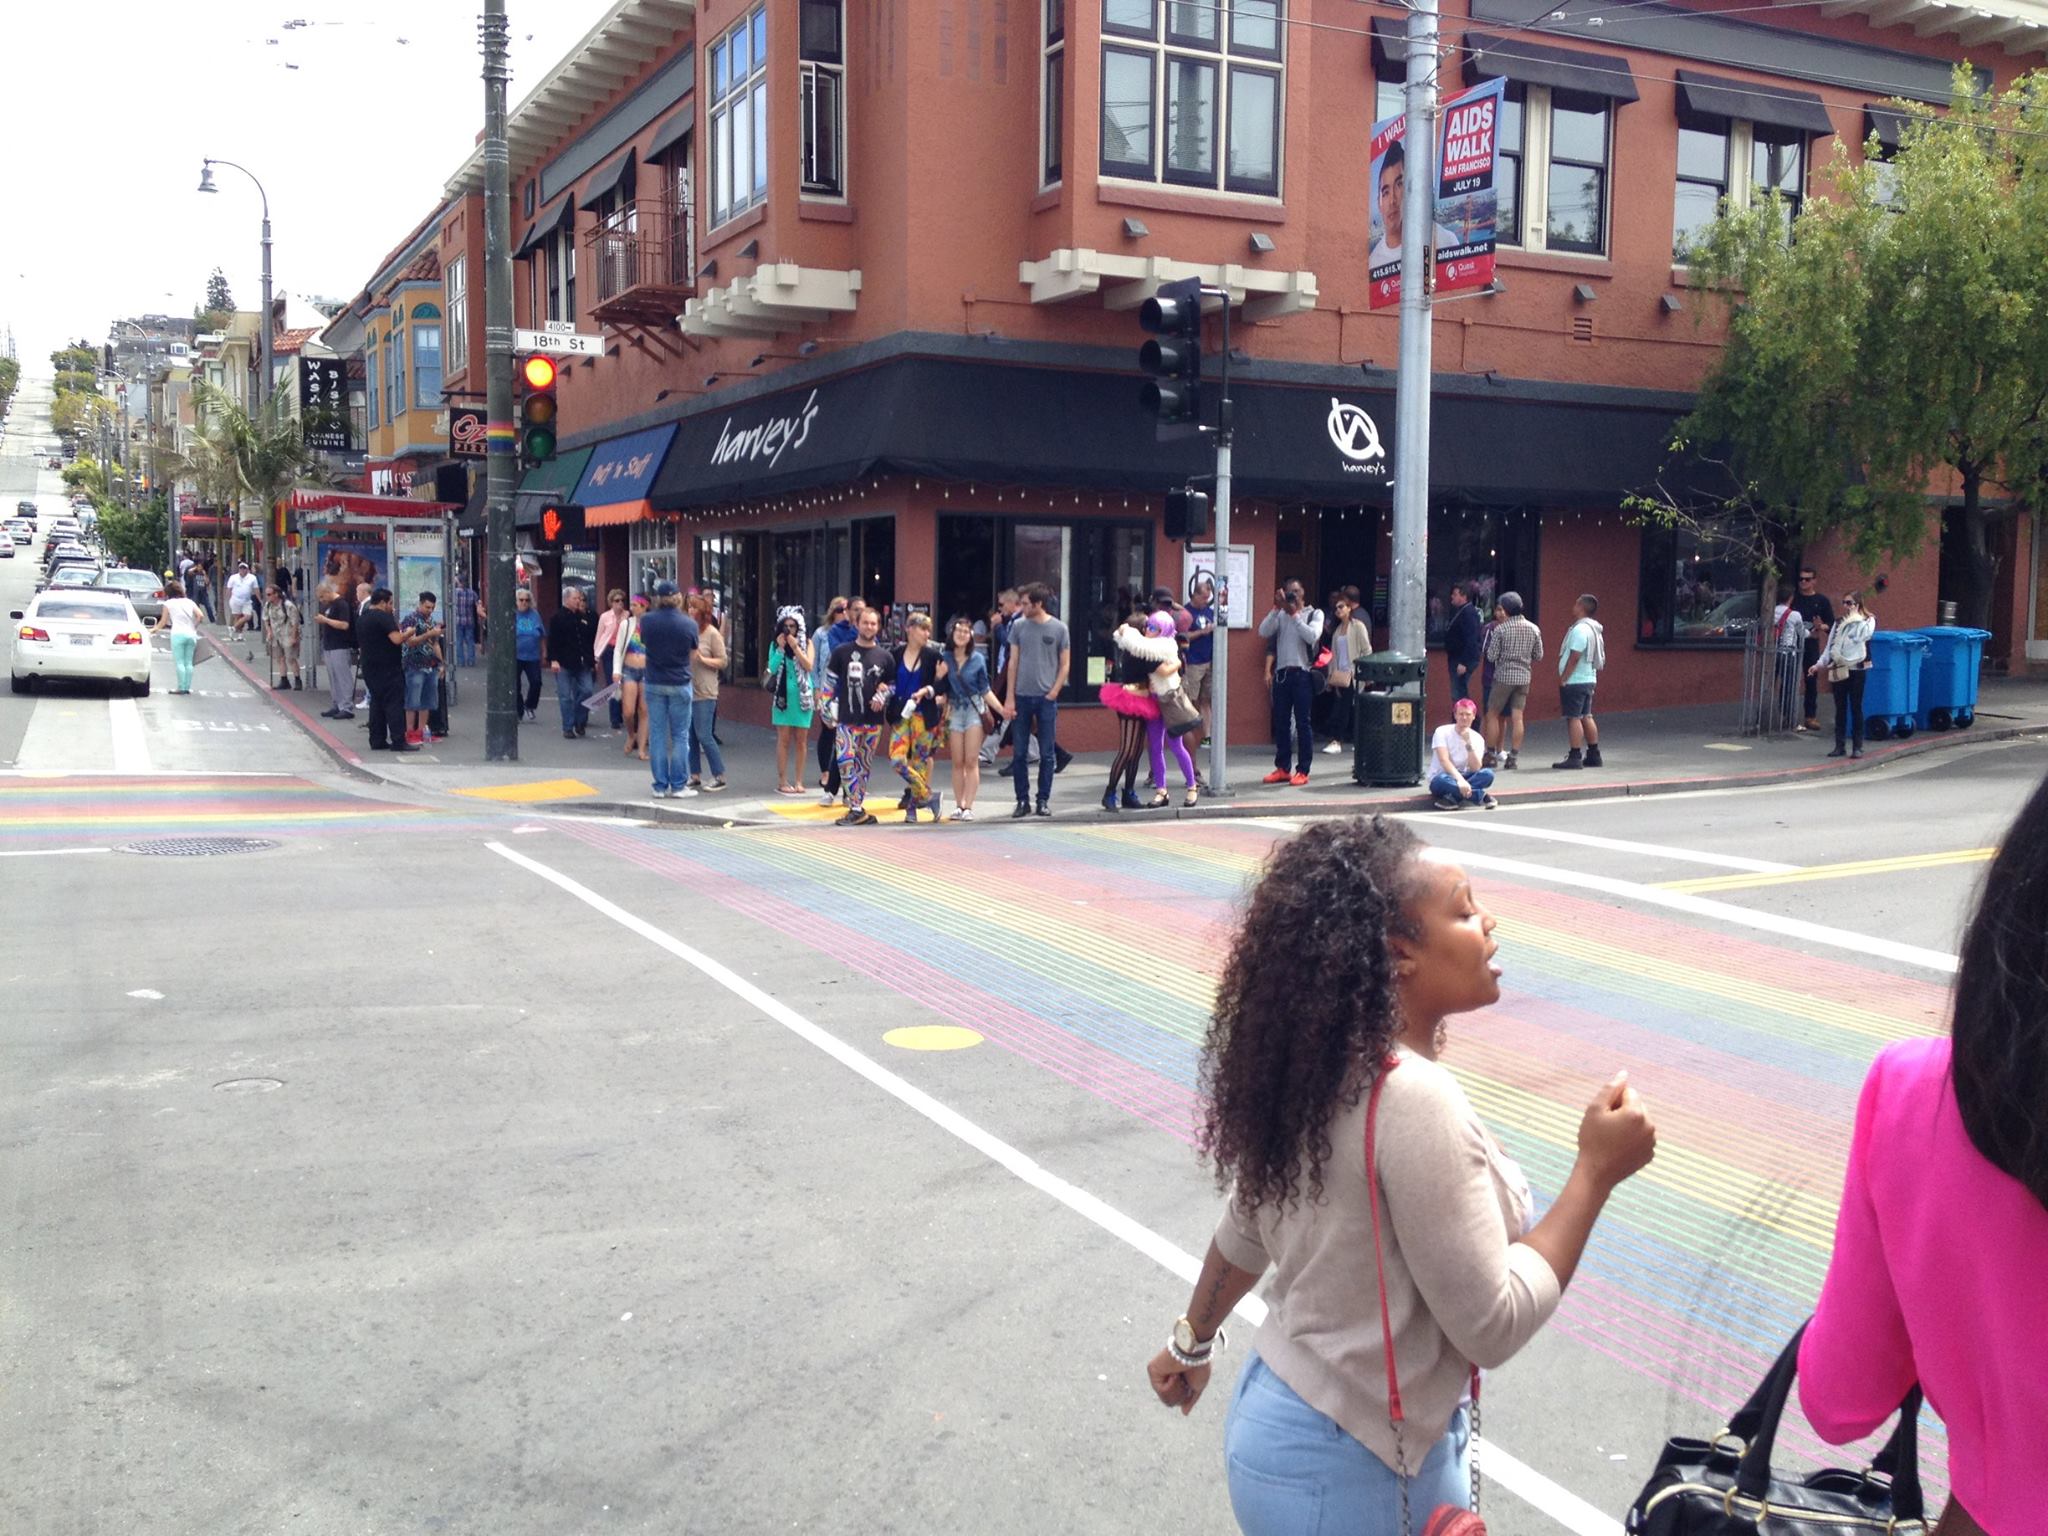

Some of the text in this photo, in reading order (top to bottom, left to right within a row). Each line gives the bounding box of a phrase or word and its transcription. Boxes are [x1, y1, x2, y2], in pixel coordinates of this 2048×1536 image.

[1447, 102, 1494, 139] AIDS
[1446, 131, 1491, 163] WALK
[1444, 156, 1491, 177] SAN FRANCISCO
[1453, 176, 1481, 192] JULY 19
[1437, 243, 1488, 261] aidswalk.net
[548, 322, 566, 332] 4100
[533, 335, 585, 351] 18th St
[307, 360, 321, 426] WASA
[711, 388, 819, 469] harvey's
[454, 441, 488, 454] PIZZ
[1342, 461, 1386, 475] harvey's
